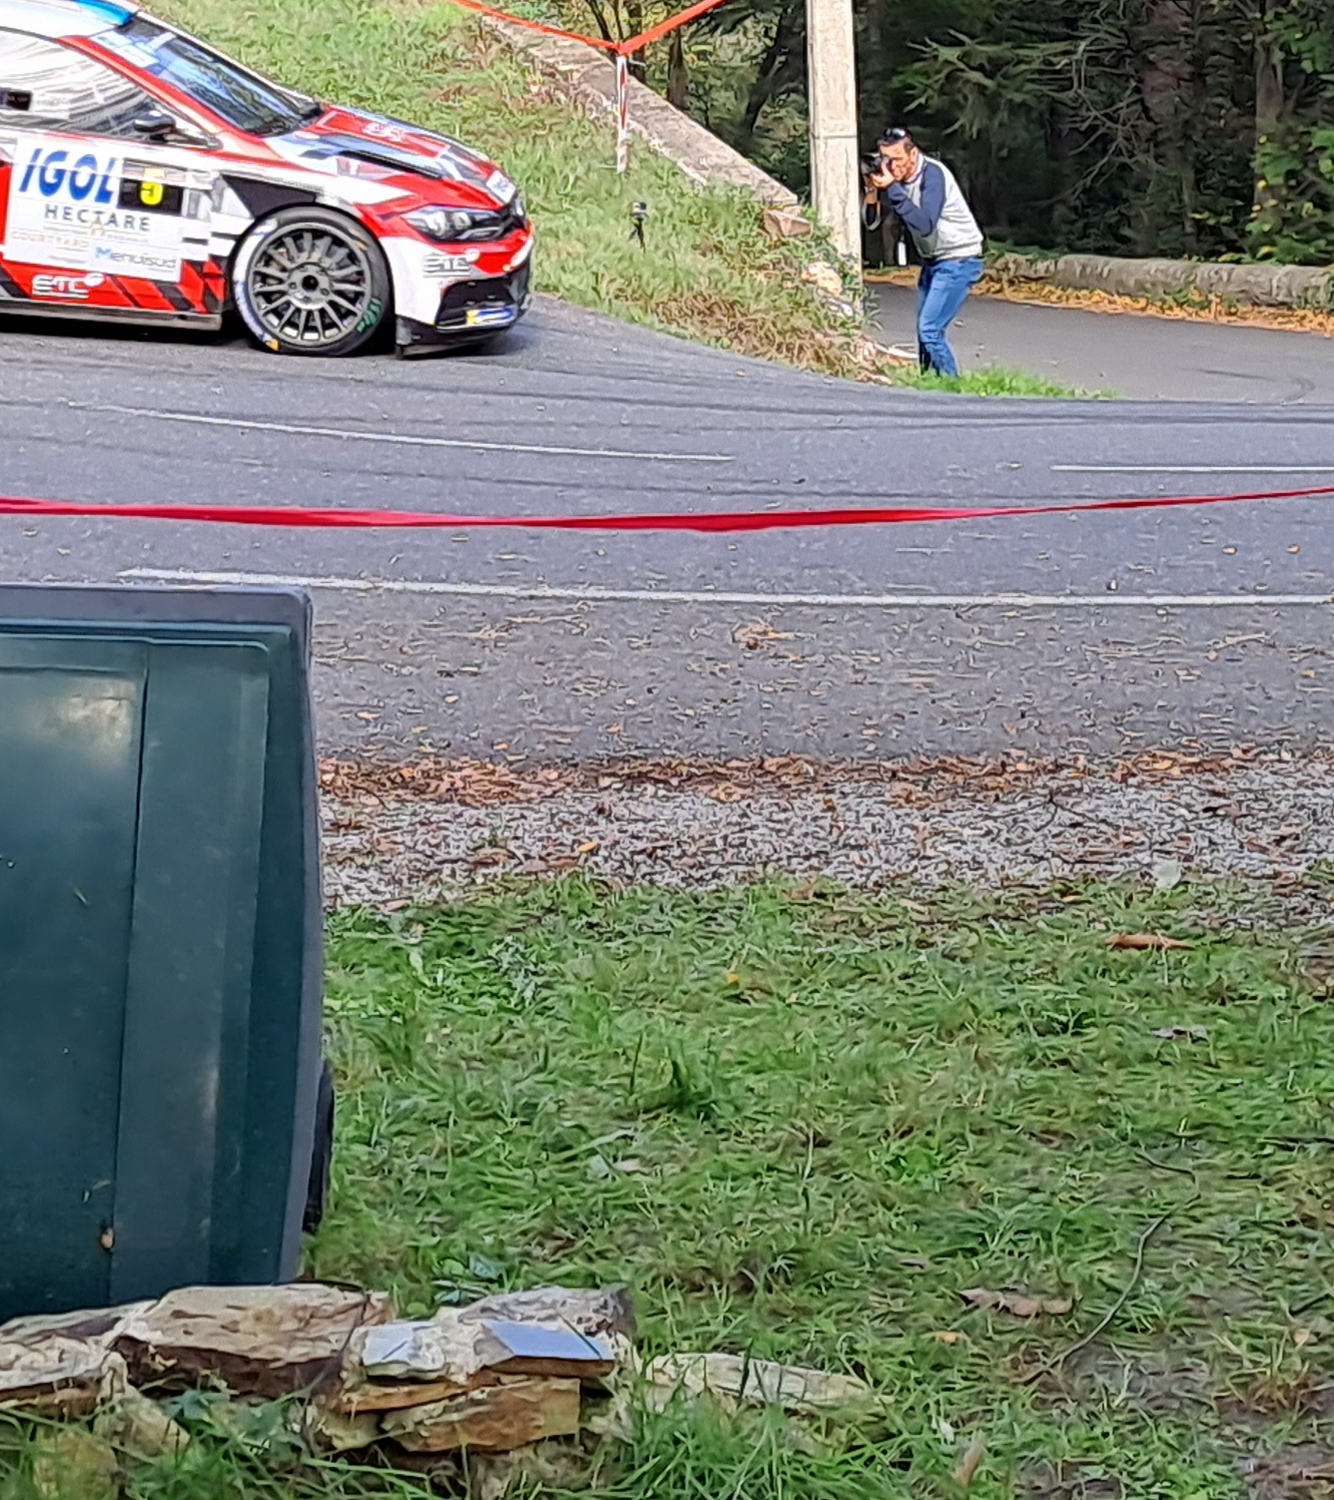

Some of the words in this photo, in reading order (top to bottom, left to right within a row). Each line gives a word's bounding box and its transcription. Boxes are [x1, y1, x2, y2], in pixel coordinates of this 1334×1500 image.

[18, 148, 119, 204] IGOL
[139, 168, 167, 206] 5
[44, 204, 152, 232] HECTARE
